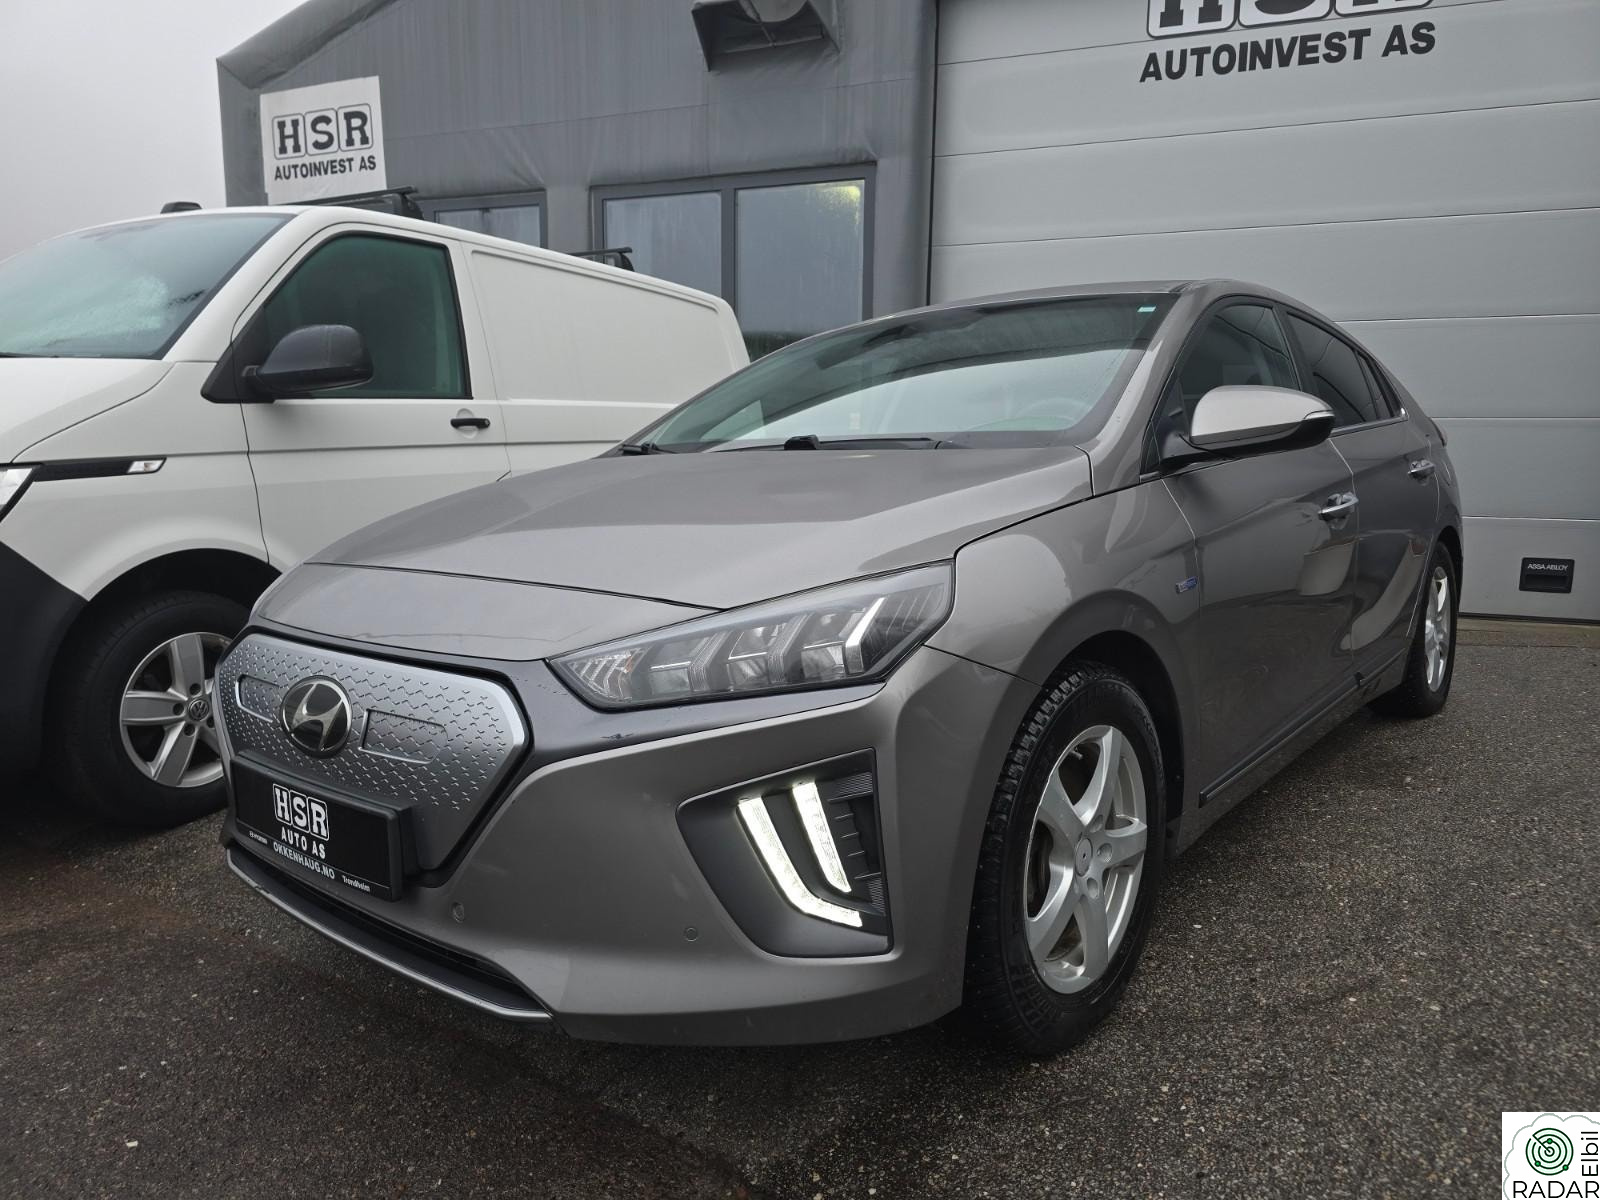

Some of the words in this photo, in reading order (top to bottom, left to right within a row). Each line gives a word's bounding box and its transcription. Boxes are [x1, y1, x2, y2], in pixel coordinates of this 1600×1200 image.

[1139, 27, 1371, 82] AUTOINVEST
[1381, 21, 1436, 58] AS
[276, 110, 370, 155] HSR
[274, 158, 354, 181] AUTOINVEST
[358, 155, 377, 171] AS
[274, 787, 328, 837] HSR
[273, 842, 336, 880] OKKENHAUG.NO
[281, 827, 307, 851] AUTO
[311, 840, 326, 859] AS
